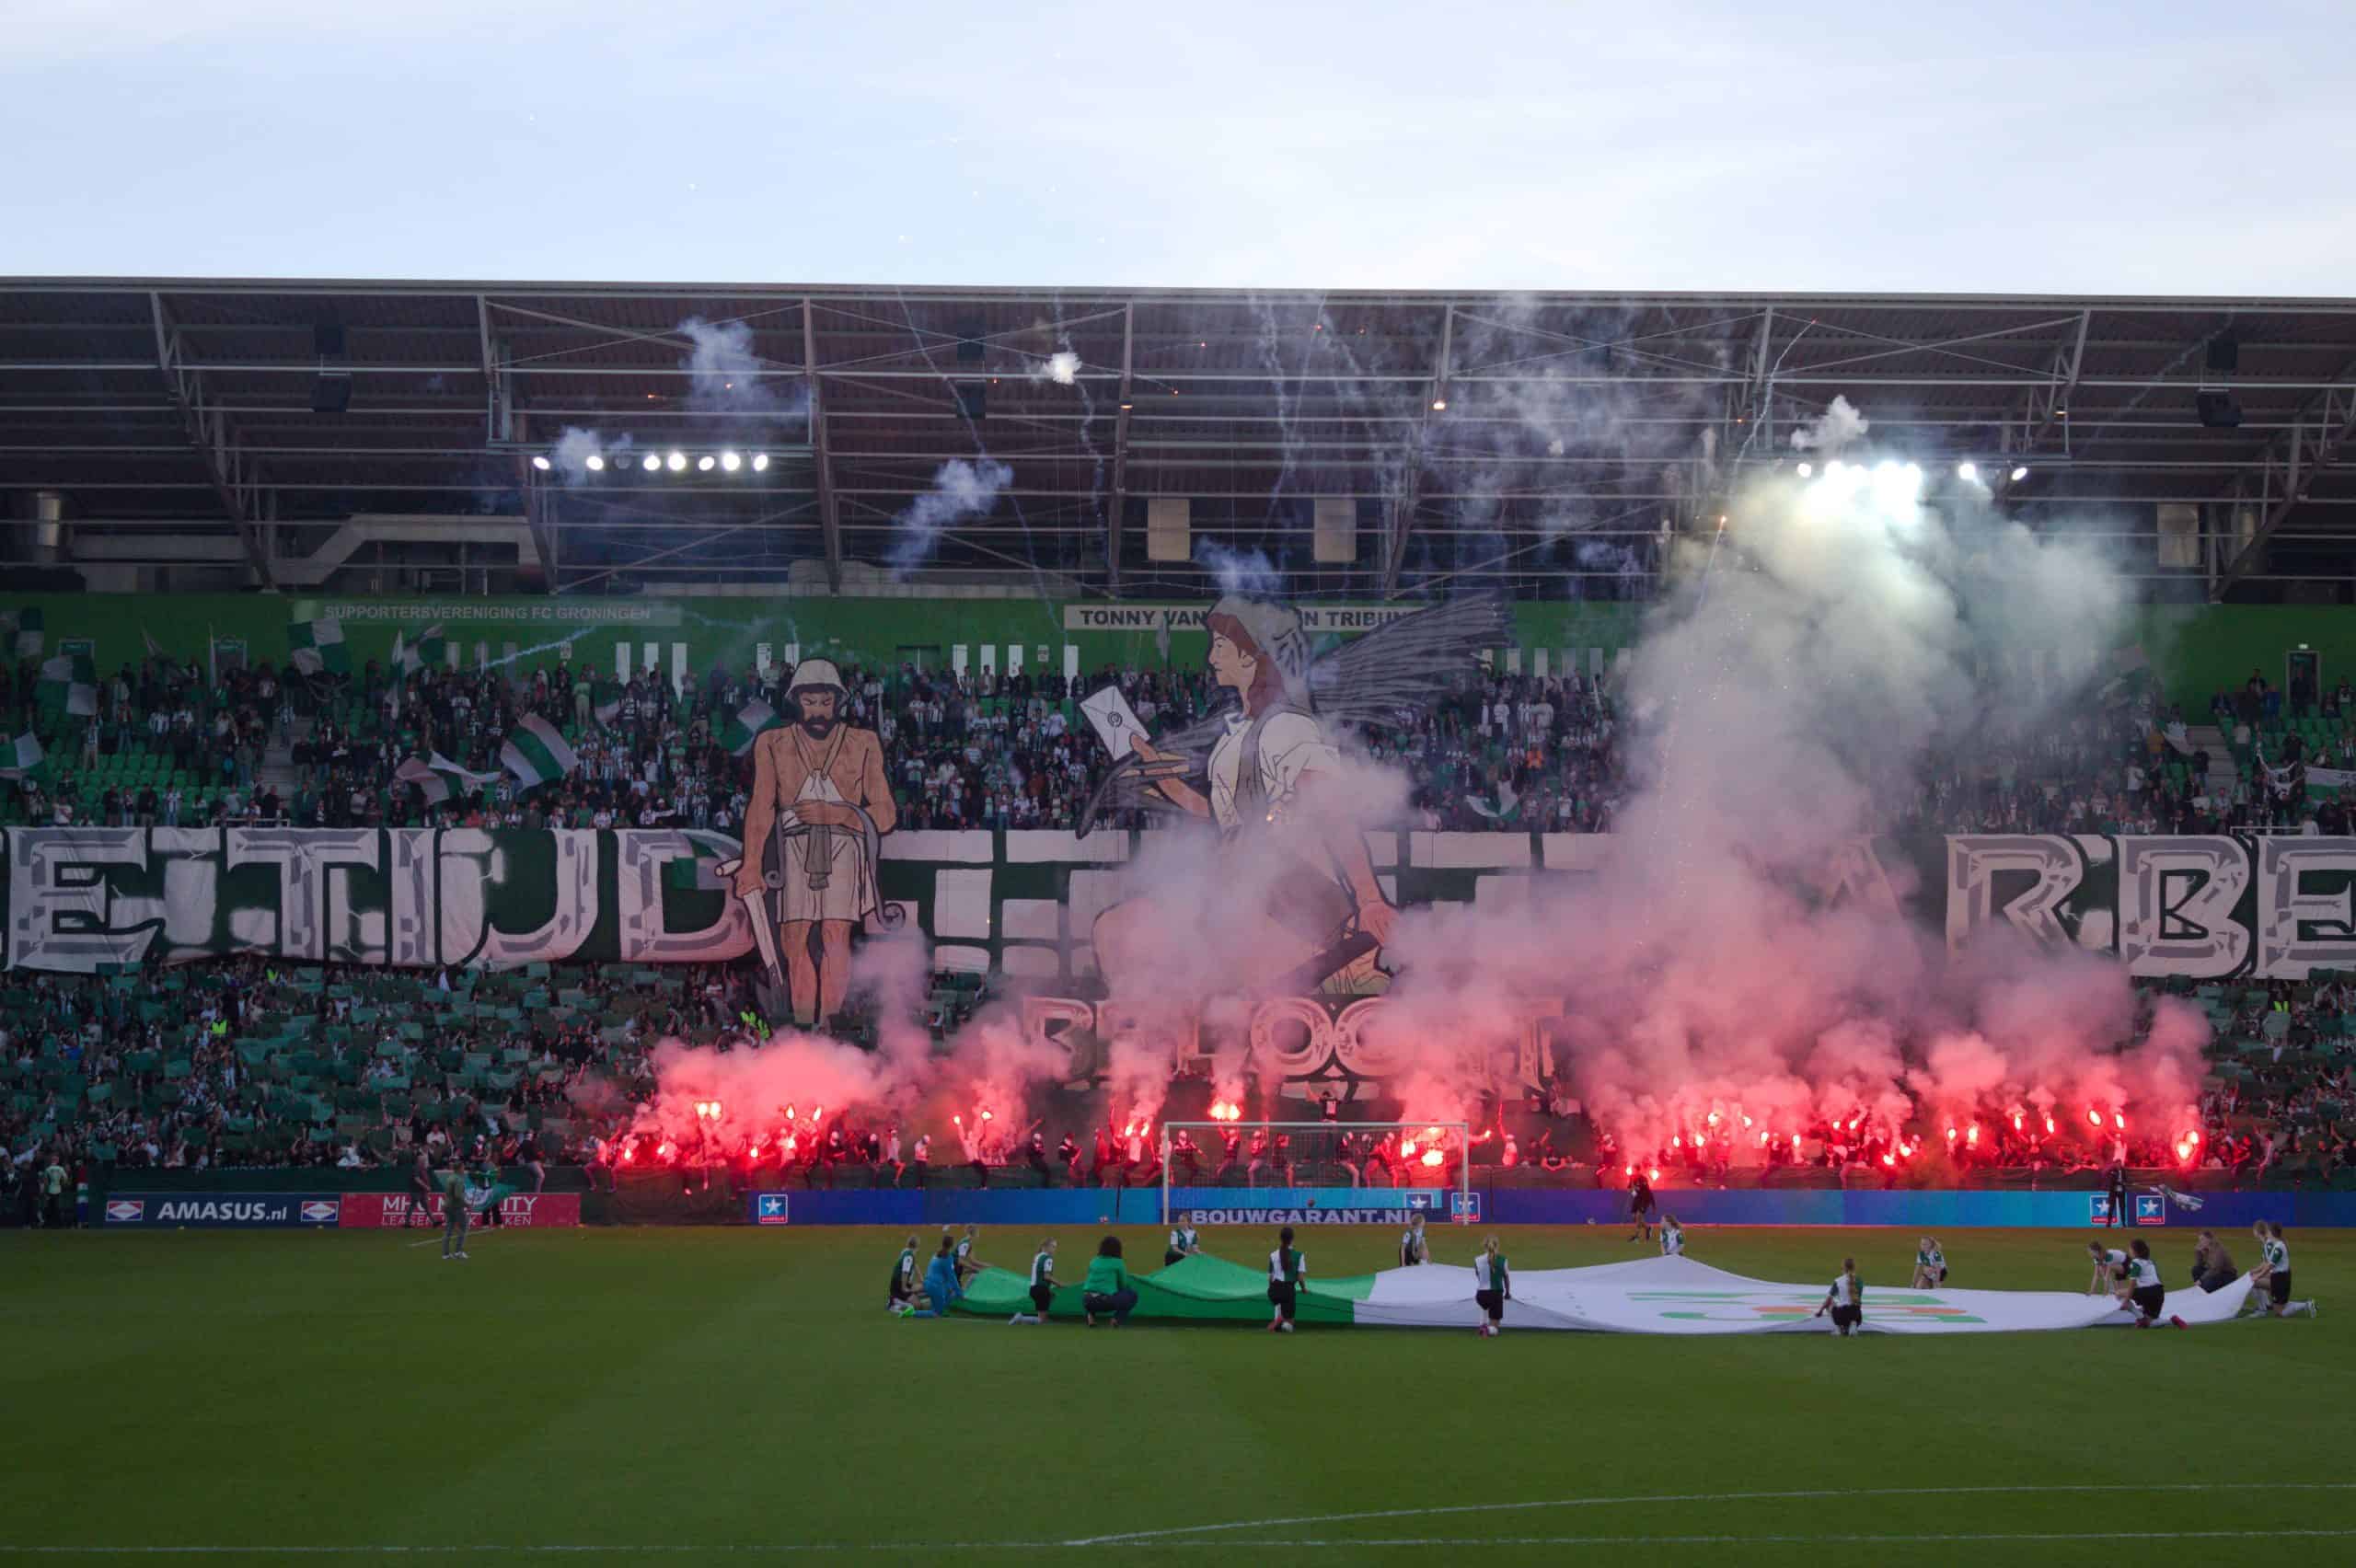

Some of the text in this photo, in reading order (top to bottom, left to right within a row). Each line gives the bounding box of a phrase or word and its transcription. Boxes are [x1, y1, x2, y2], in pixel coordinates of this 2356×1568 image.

[324, 605, 651, 619] SUPPORTERSVERENIGING FC GRONINGEN
[1080, 610, 1155, 626] TONNY
[157, 1201, 288, 1221] AMASUS.nl
